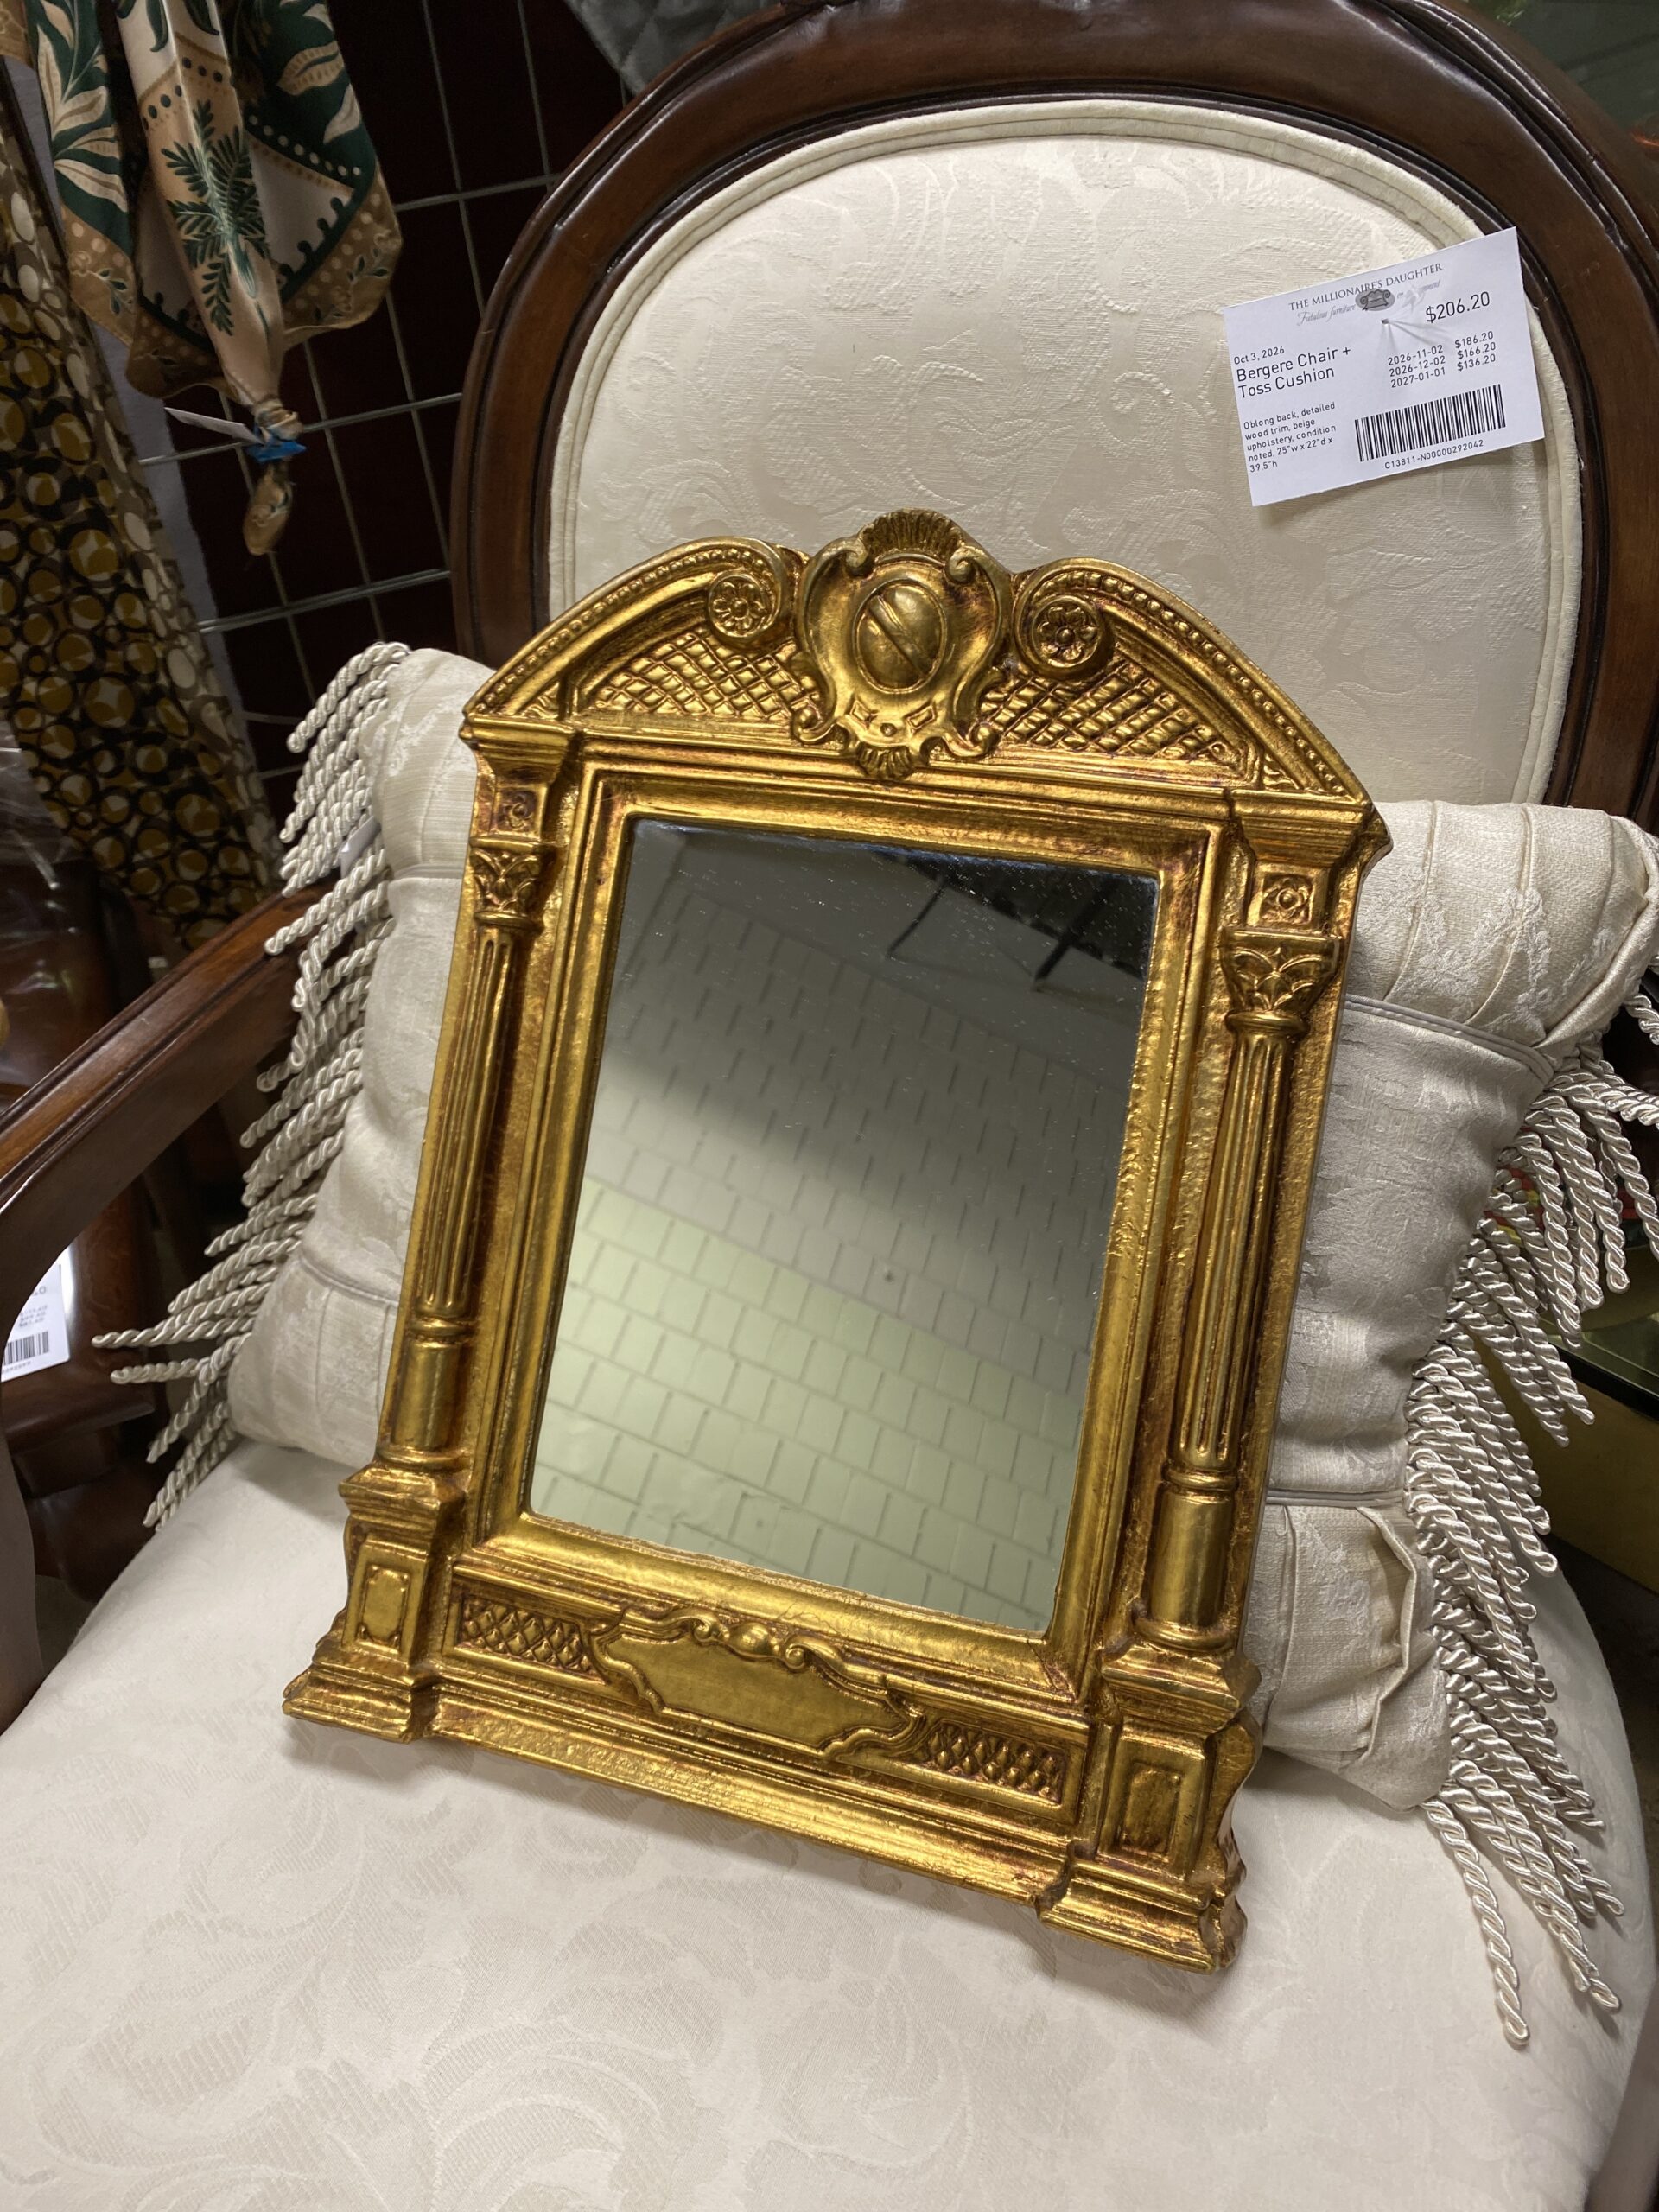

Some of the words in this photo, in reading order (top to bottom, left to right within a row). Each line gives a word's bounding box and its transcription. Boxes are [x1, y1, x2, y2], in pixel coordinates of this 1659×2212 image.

[1289, 300, 1308, 311] THE
[1385, 263, 1443, 287] DAUGHTER
[1297, 309, 1327, 326] Fabulous
[1325, 304, 1357, 323] furniture
[1426, 291, 1491, 323] $206.20
[1234, 354, 1249, 365] Oct
[1250, 352, 1260, 361] 3,
[1262, 346, 1285, 359] 2026
[1388, 345, 1444, 366] 2026-11-02
[1455, 331, 1494, 349] $186.20
[1389, 355, 1446, 378] 2026-12-02
[1457, 341, 1496, 359] $166.20
[1236, 360, 1294, 382] Bergere
[1297, 347, 1338, 367] Chair
[1343, 346, 1351, 355] +
[1390, 366, 1446, 388] 2027-01-01
[1457, 353, 1496, 372] $136.20
[1238, 383, 1272, 398] Toss
[1275, 367, 1335, 390] Cushion
[1243, 417, 1274, 429] Oblong
[1277, 411, 1300, 423] back,
[1301, 402, 1335, 416] detailed
[1245, 429, 1268, 440] wood
[1270, 424, 1291, 435] trim,
[1293, 418, 1315, 429] beige
[1247, 435, 1294, 452] upholstery,
[1296, 425, 1336, 440] condition
[1249, 449, 1275, 461] noted,
[1384, 439, 1484, 469] C13811-N00000292042
